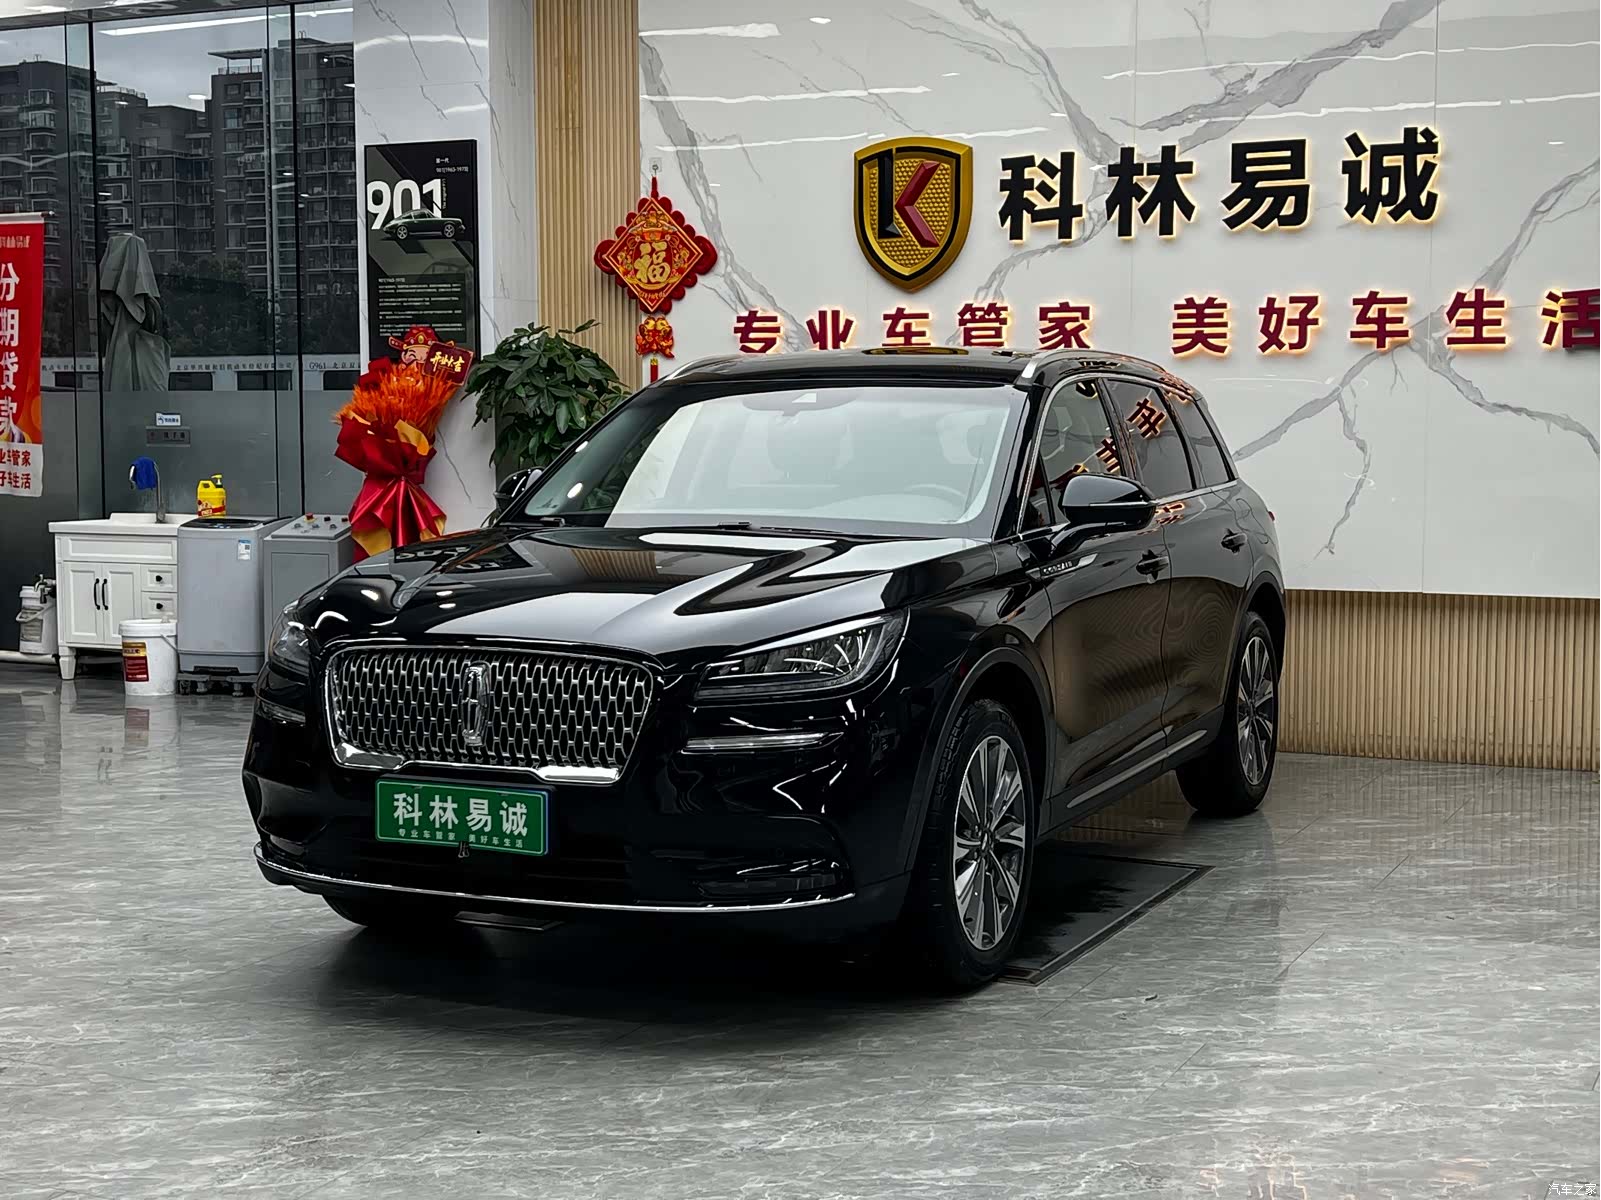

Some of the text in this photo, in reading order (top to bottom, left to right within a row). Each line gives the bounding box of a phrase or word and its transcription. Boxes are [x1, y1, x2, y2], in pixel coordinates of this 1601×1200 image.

[366, 178, 442, 230] 901
[999, 127, 1440, 241] 科林易诚
[634, 242, 671, 283] 福
[733, 288, 1600, 355] 专业车管家 美好车生活
[393, 792, 528, 837] 科林易诚
[398, 828, 523, 848] 专业车管家 美好车生活
